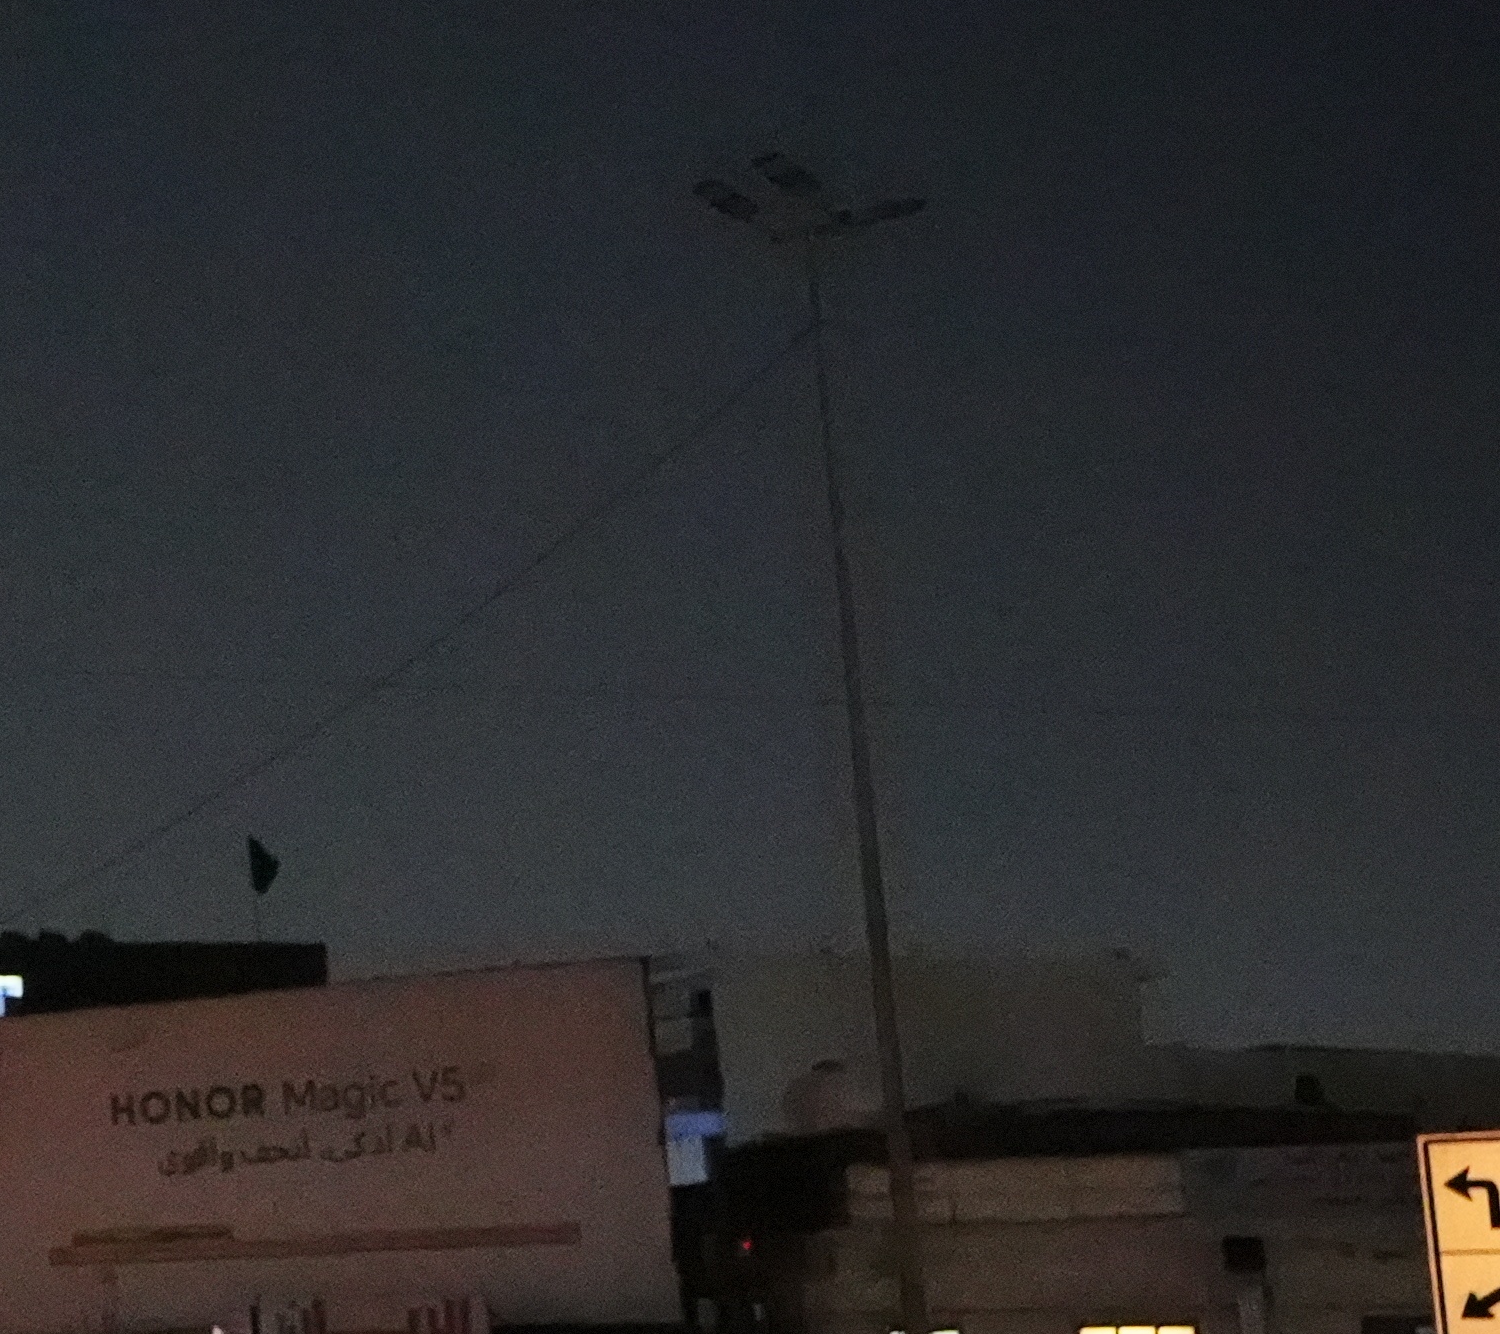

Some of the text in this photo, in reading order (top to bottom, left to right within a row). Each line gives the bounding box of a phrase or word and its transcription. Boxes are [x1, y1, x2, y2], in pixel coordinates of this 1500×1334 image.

[110, 1065, 466, 1125] HONOR Magic V5
